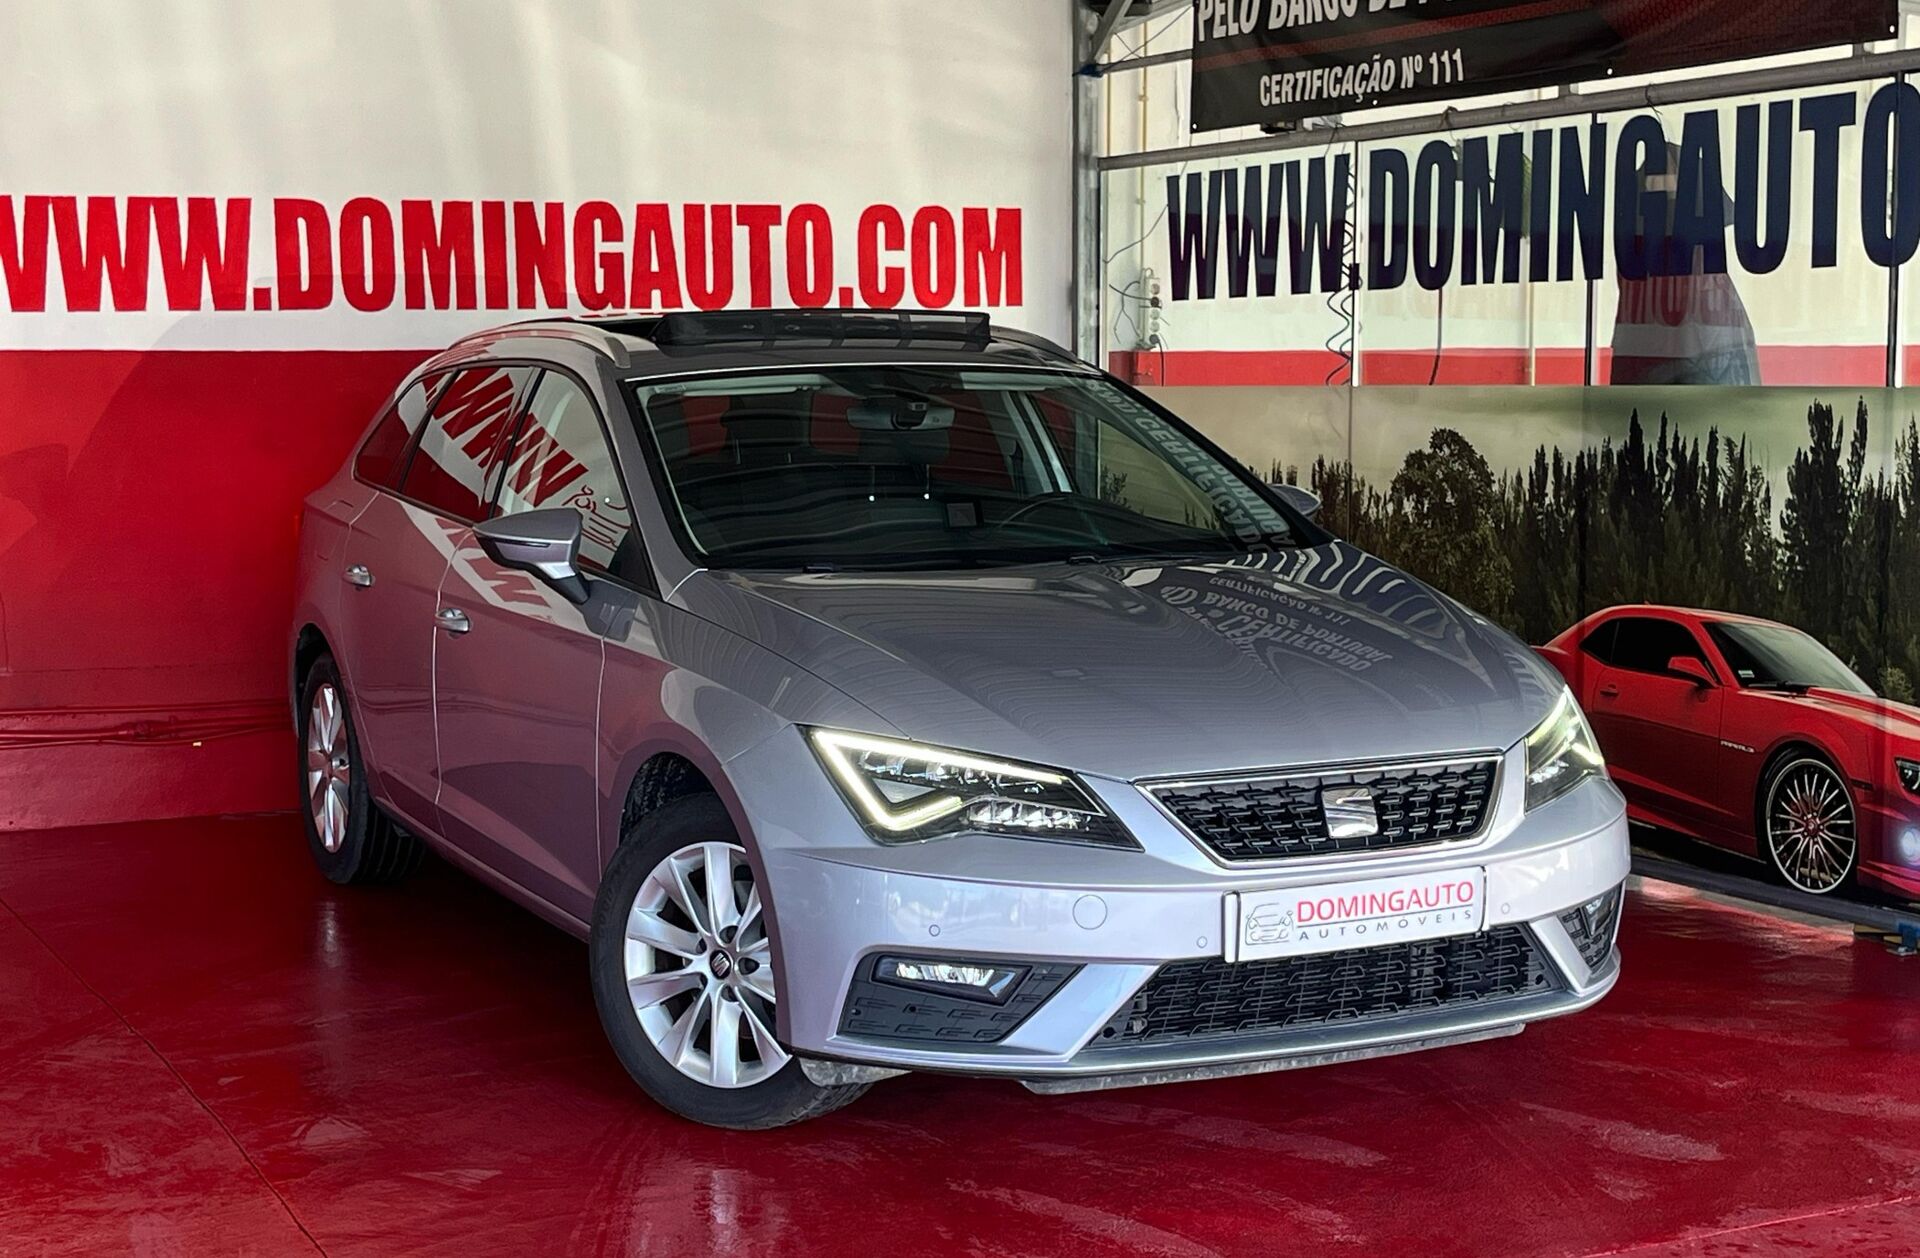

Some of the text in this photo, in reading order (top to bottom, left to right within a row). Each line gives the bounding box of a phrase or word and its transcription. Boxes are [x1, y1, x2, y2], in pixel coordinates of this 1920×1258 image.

[1198, 0, 1261, 41] PELO
[1260, 53, 1396, 107] CERTIFICAÇÃO
[1429, 48, 1464, 85] 111
[1296, 881, 1475, 923] DOMINGAUTO
[1299, 909, 1472, 942] AUTOMÓVEIS
